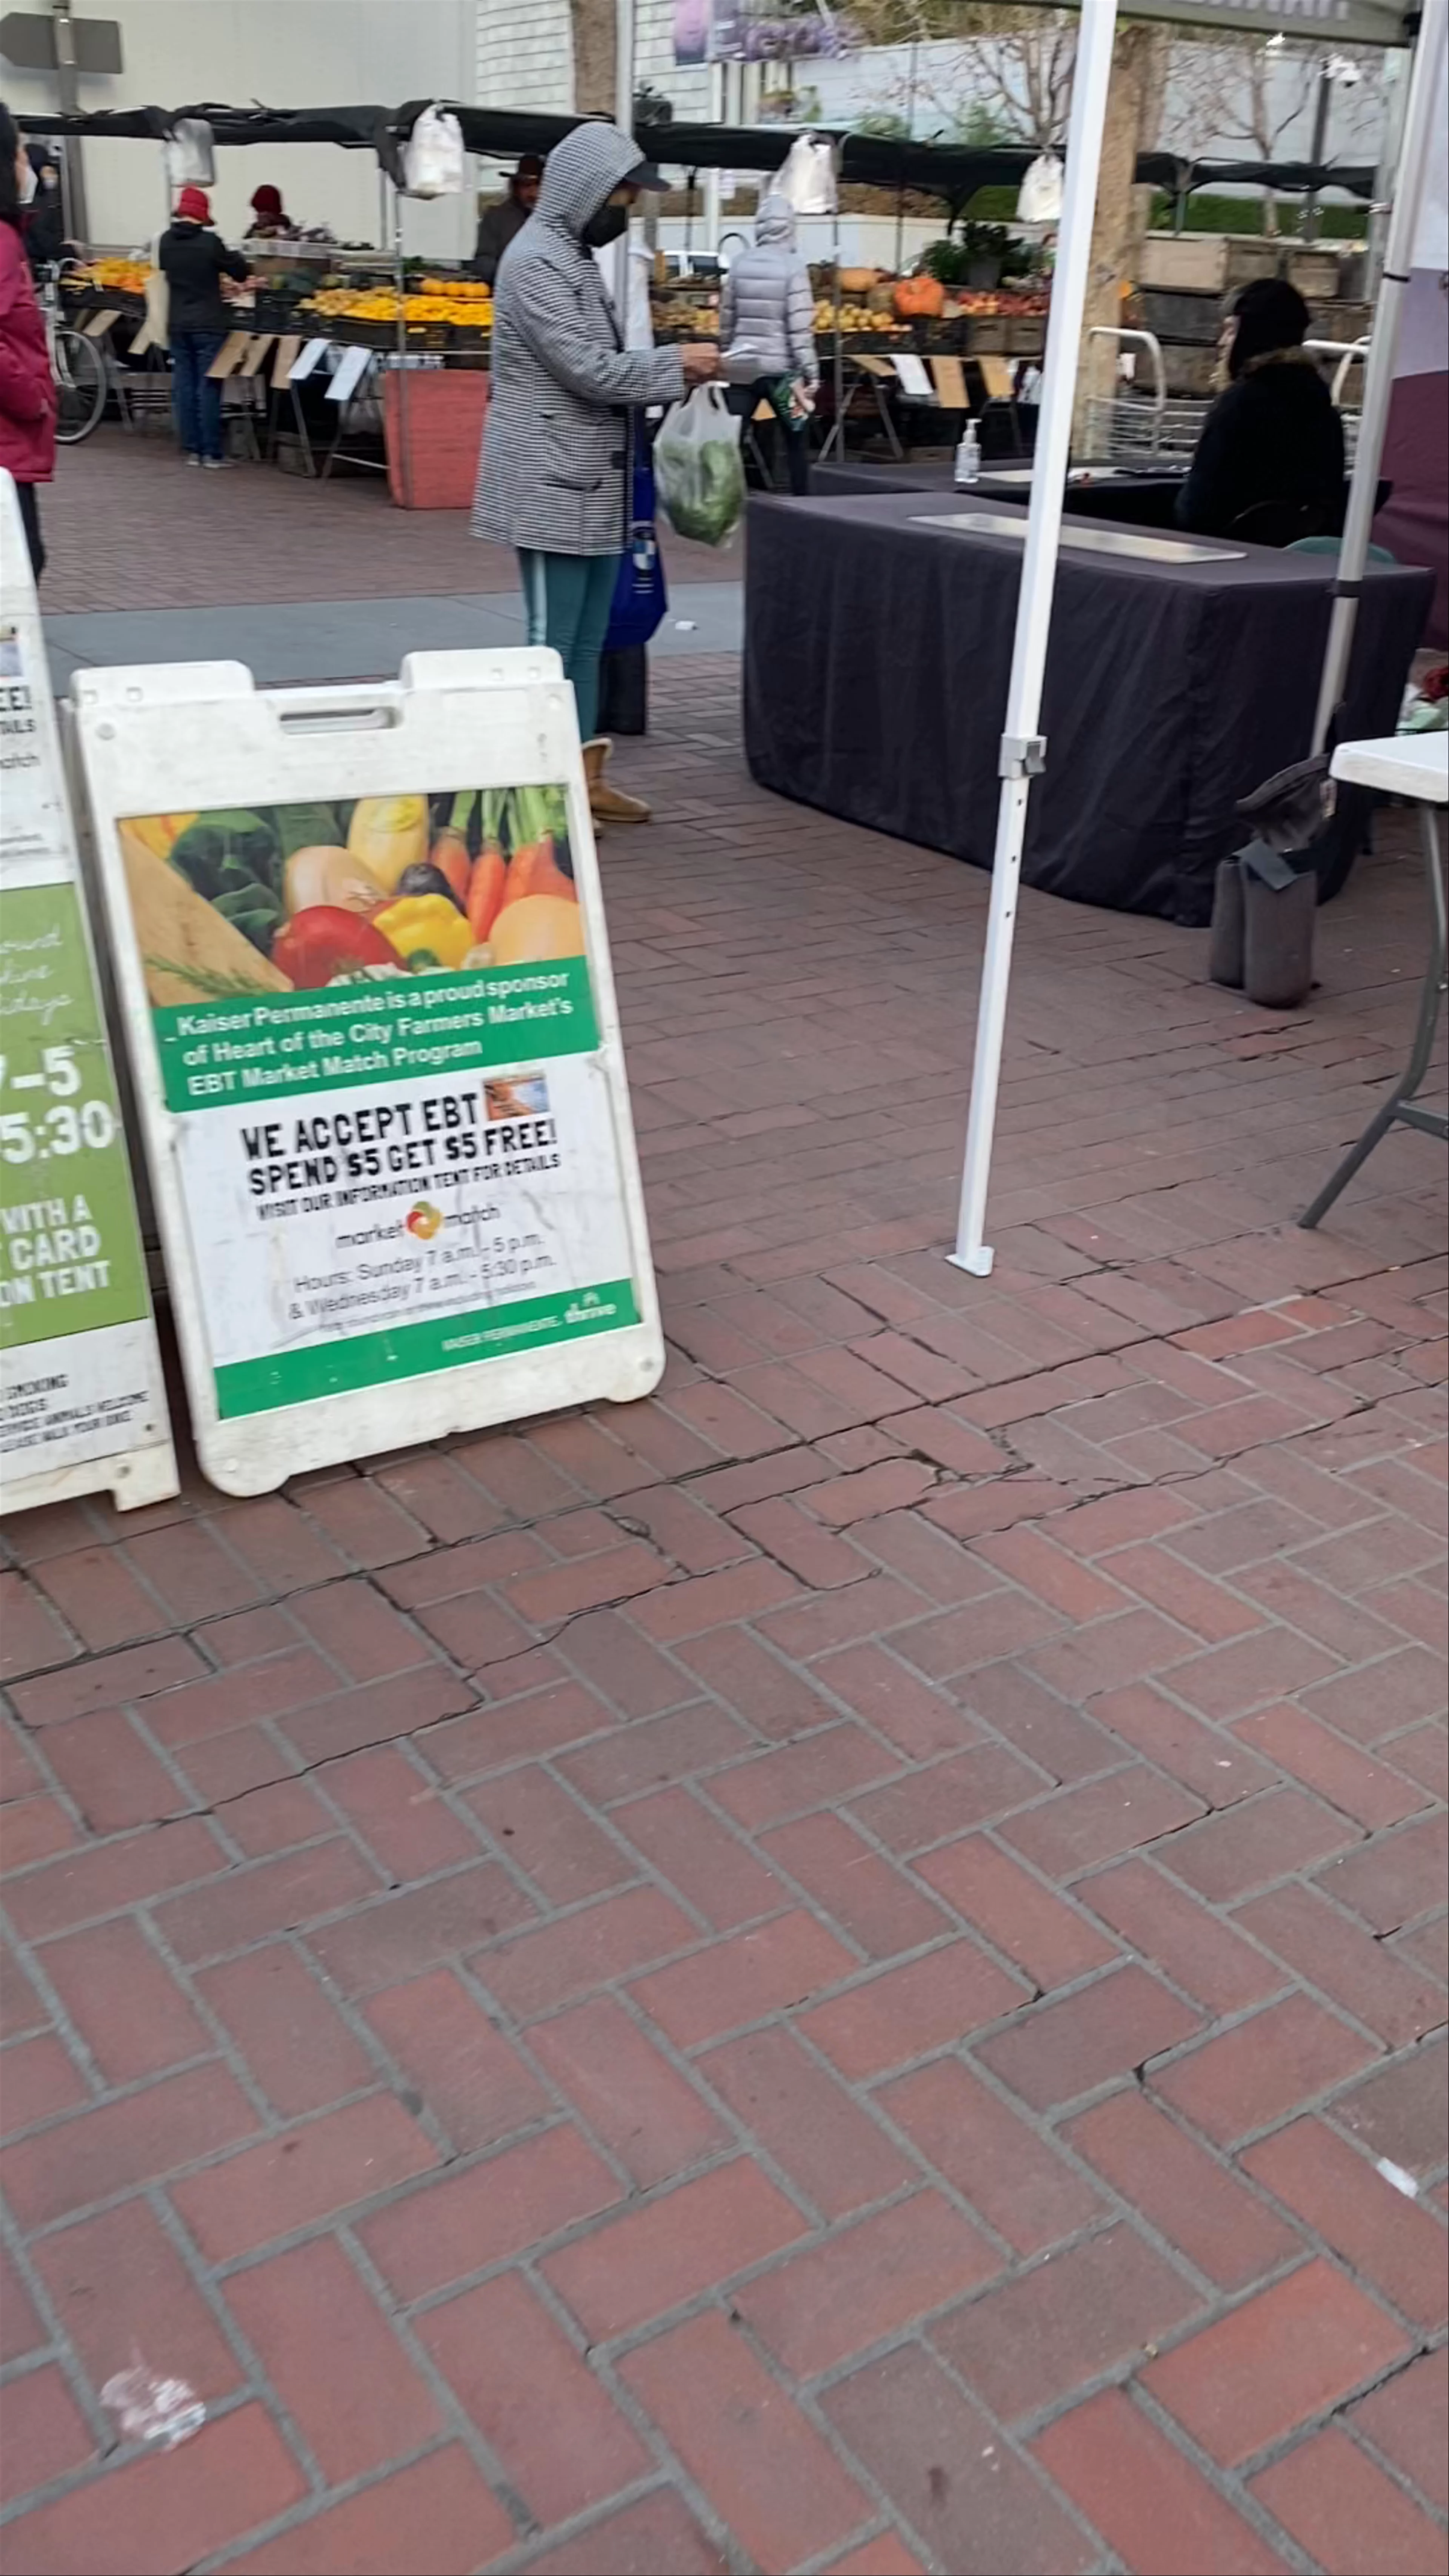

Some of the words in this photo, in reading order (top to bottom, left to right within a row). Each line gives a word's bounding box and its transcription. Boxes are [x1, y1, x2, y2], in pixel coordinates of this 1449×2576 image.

[177, 1013, 252, 1036] Kaiser
[253, 995, 384, 1026] Permanente
[385, 991, 406, 1009] is
[409, 992, 422, 1007] a
[423, 979, 485, 1009] proud
[486, 973, 570, 999] sponsor
[183, 1044, 209, 1066] of
[211, 1037, 276, 1062] Heart
[280, 1030, 305, 1052] of
[308, 1029, 345, 1049] the
[349, 1022, 392, 1044] City
[397, 1012, 485, 1037] Farmers
[488, 997, 574, 1024] Market's
[188, 1070, 237, 1096] EBT
[241, 1061, 320, 1088] Market
[321, 1051, 389, 1076] Match
[392, 1041, 483, 1066] Program
[0, 1100, 114, 1164] 5:30
[240, 1122, 286, 1161] WE
[295, 1103, 412, 1153] ACCEPT
[422, 1092, 477, 1132] EBT
[249, 1155, 339, 1195] SPEND
[348, 1148, 381, 1177] $5
[388, 1139, 435, 1173] GET
[445, 1132, 478, 1160] $5
[484, 1118, 558, 1155] FREE!
[0, 1197, 69, 1235] WITH
[72, 1193, 94, 1223] A
[256, 1199, 298, 1221] VISIT
[302, 1193, 333, 1212] OUR
[336, 1178, 431, 1208] INFORMATION
[434, 1169, 470, 1189] TENT
[473, 1163, 503, 1182] FOR
[506, 1153, 561, 1176] DETAILS
[8, 1224, 101, 1271] CARD
[335, 1220, 405, 1249] market
[444, 1203, 501, 1228] match
[356, 1257, 423, 1280] Sunday
[425, 1249, 437, 1265] 7
[493, 1236, 505, 1252] 5
[507, 1233, 546, 1253] p.m.
[36, 1259, 111, 1299] TENT
[288, 1303, 305, 1320] &
[305, 1284, 411, 1315] Wednesday
[414, 1277, 424, 1293] 7
[481, 1258, 517, 1280] 5:30
[520, 1255, 557, 1275] p.m.
